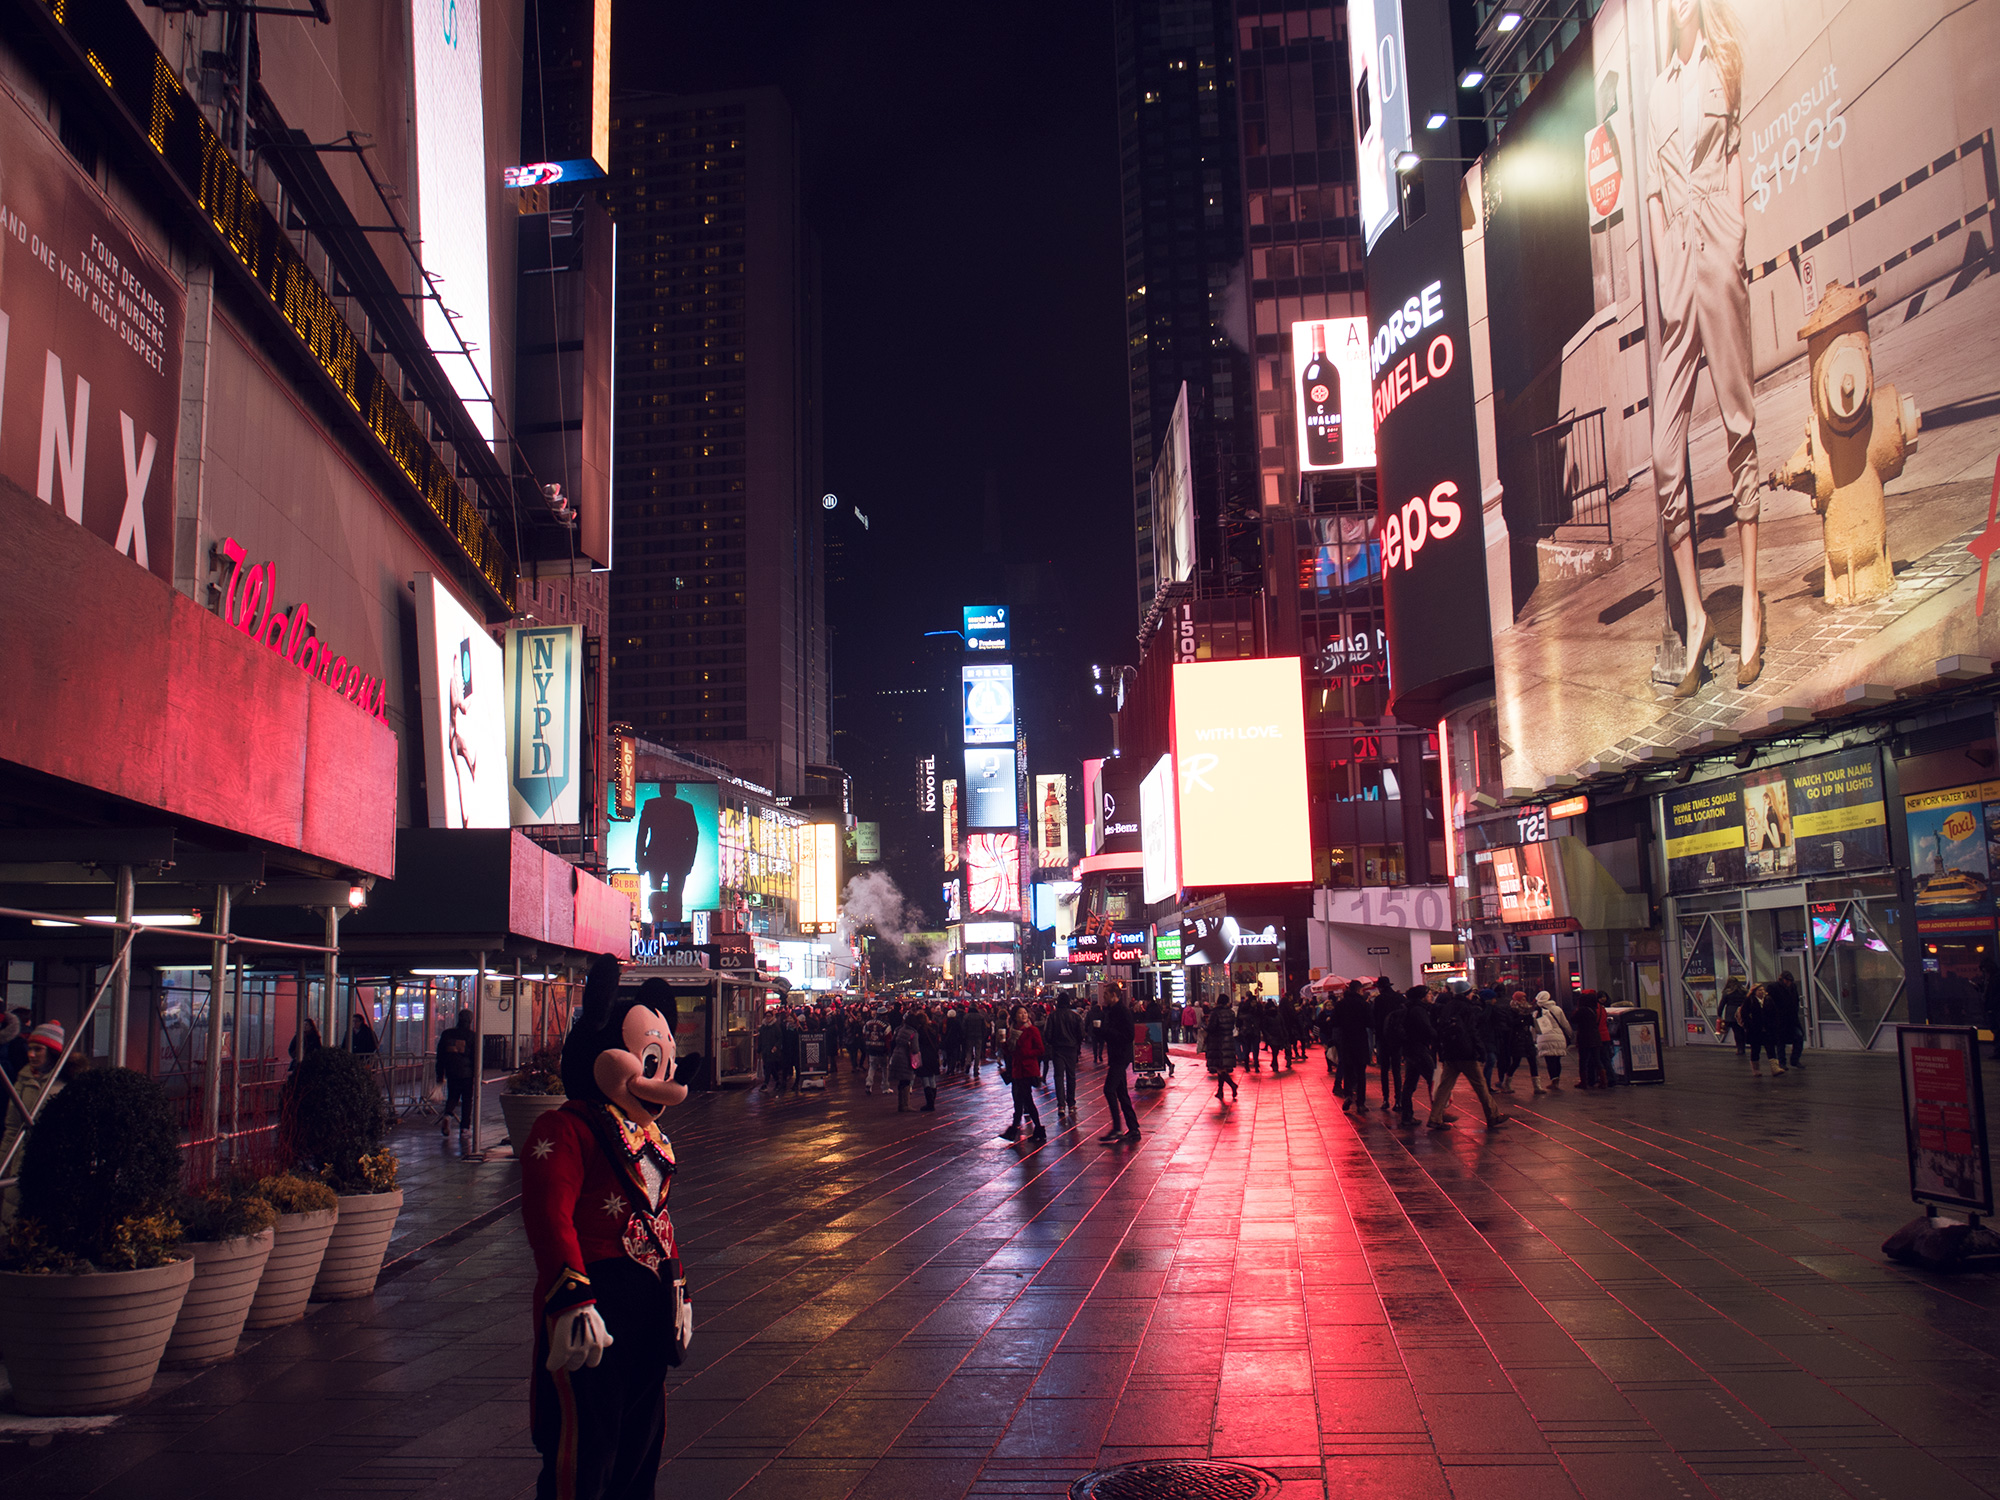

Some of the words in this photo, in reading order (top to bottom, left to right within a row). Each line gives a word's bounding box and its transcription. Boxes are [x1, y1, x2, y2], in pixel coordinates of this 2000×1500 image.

[1748, 64, 1838, 163] Jumpsuit
[1750, 97, 1847, 213] $19.95
[1596, 179, 1617, 202] ENTER
[0, 204, 27, 243] AND
[31, 234, 56, 273] ONE
[60, 260, 89, 302] VERY
[92, 292, 118, 331] RICH
[120, 320, 165, 377] SUSPECT.
[90, 233, 119, 277] FOUR
[121, 266, 168, 328] DECADES.
[81, 251, 115, 301] THREE
[118, 290, 166, 353] MURDERS.
[1370, 280, 1444, 380] HORSE
[532, 637, 555, 775] NYPD
[1195, 727, 1234, 741] WITH
[1238, 725, 1283, 740] LOVE.
[925, 754, 936, 812] NOVOTEL
[1793, 773, 1822, 788] WATCH
[1823, 768, 1846, 782] YOUR
[1847, 762, 1873, 777] NAME
[1806, 787, 1820, 799] GO
[1822, 785, 1833, 797] UP
[1835, 783, 1845, 794] IN
[1846, 777, 1874, 792] LIGHTS
[1673, 802, 1691, 815] PRIME
[1692, 798, 1710, 811] TIMES
[1711, 792, 1737, 807] SQUARE
[1907, 799, 1921, 808] NEW
[1922, 796, 1940, 806] YORK
[1962, 789, 1977, 799] TAXI
[1674, 814, 1693, 827] RETAIL
[1694, 807, 1726, 822] LOCATION
[1747, 807, 1759, 849] Retail
[1942, 810, 1975, 839] Taxi!
[614, 878, 639, 888] BUBBA
[1229, 934, 1277, 946] CITIZEN
[635, 950, 702, 967] snackBOX
[1113, 948, 1142, 960] don't
